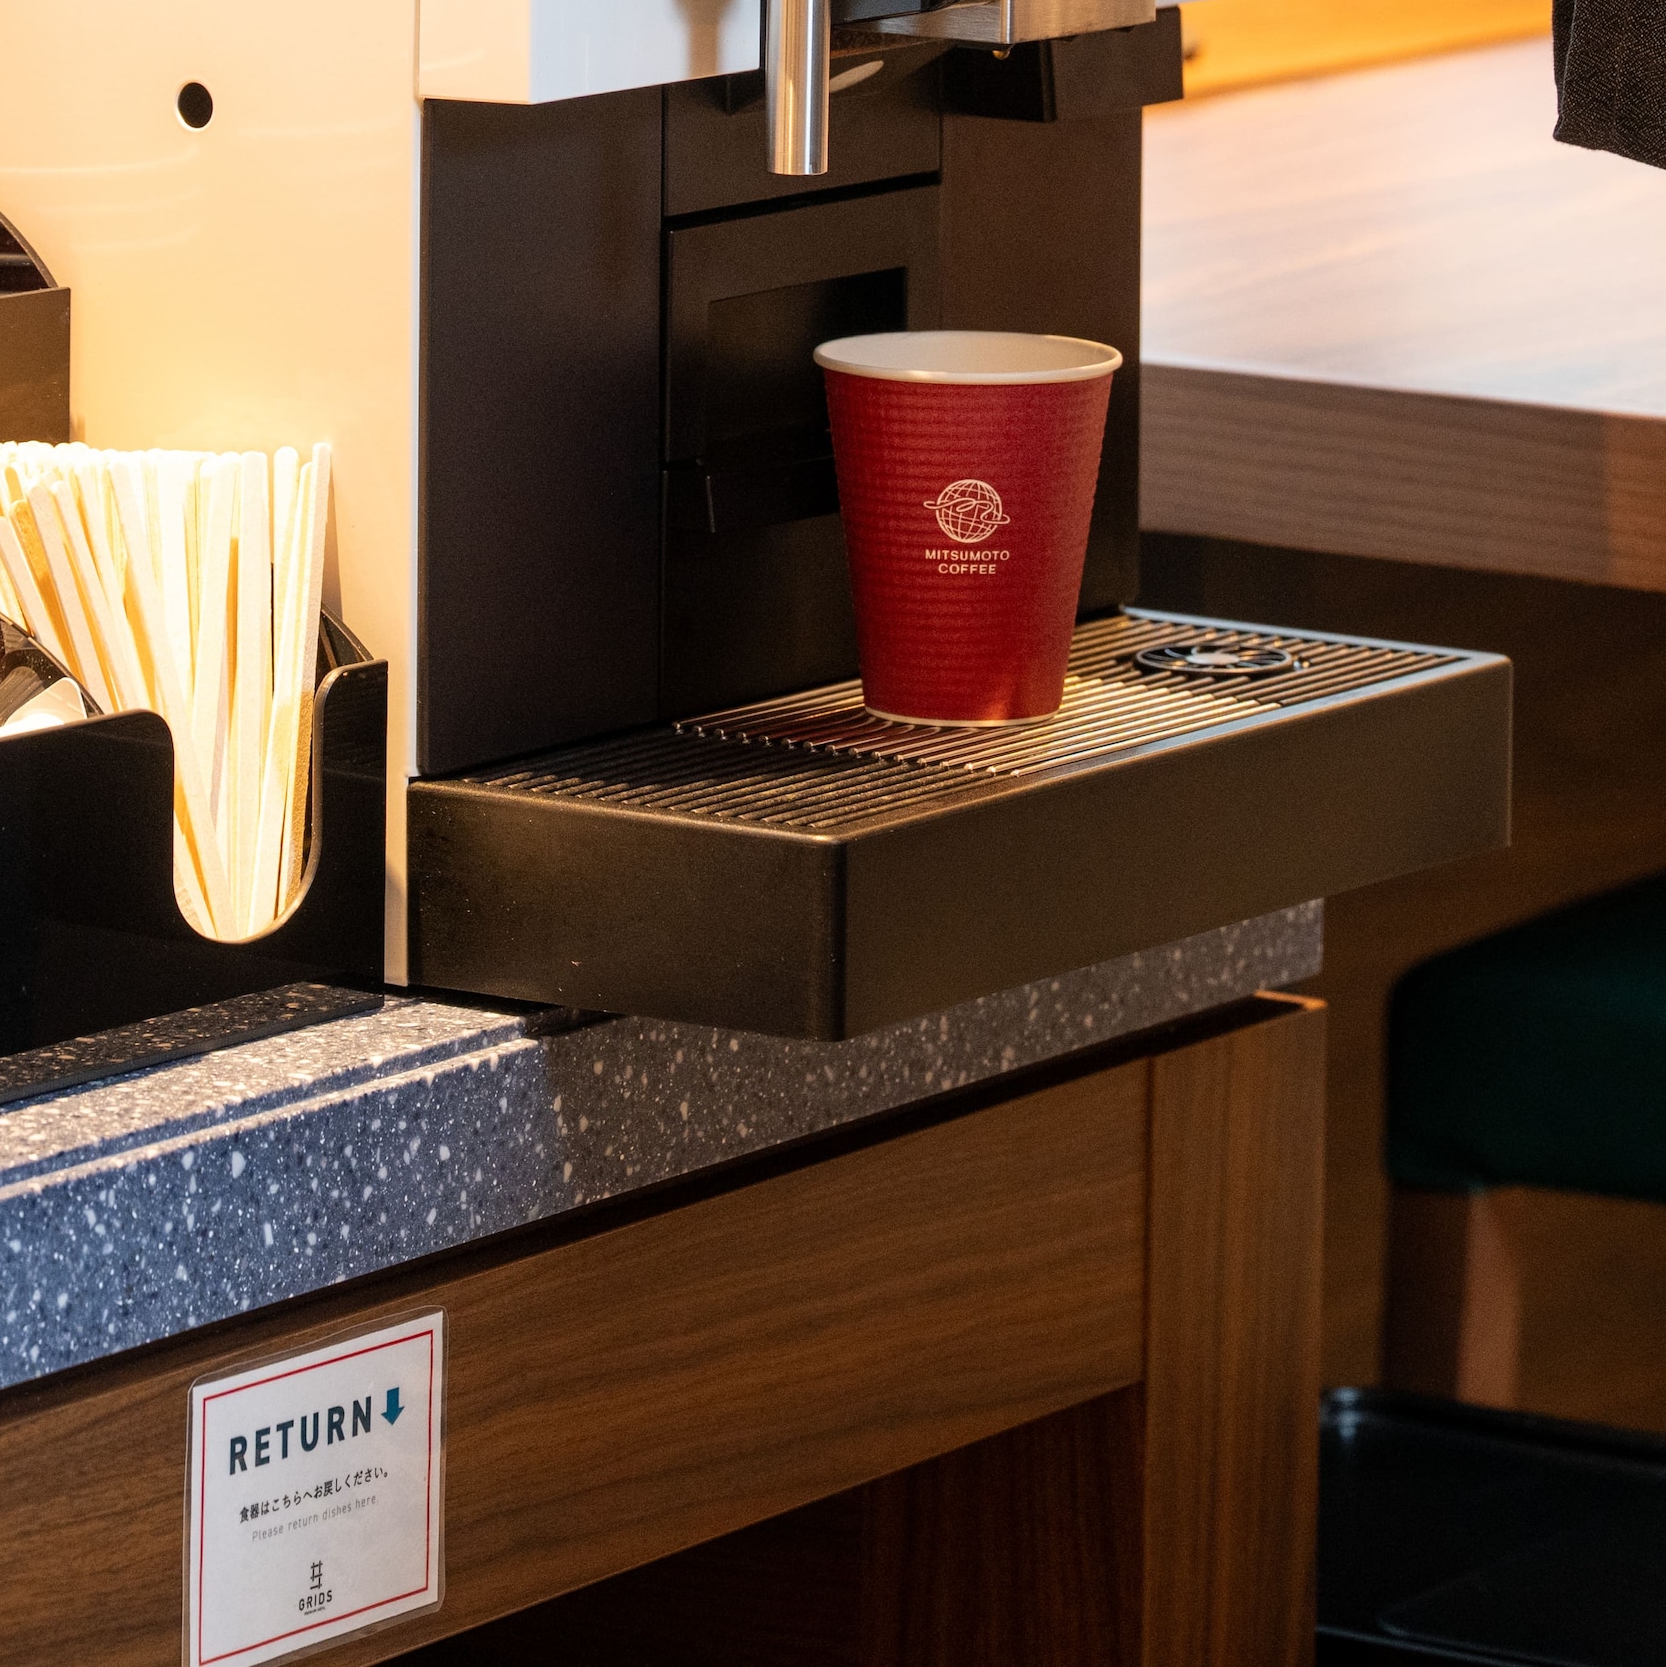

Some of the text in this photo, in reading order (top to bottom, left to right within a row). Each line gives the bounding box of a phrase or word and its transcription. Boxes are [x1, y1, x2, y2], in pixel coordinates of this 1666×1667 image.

[925, 549, 1010, 562] MITSUMOTO
[938, 564, 996, 575] COFFEE
[229, 1395, 372, 1476] RETURN
[239, 1465, 389, 1524] 食器はこちらへお戻しください。
[252, 1522, 284, 1543] Please
[288, 1511, 319, 1532] return
[322, 1501, 352, 1521] dishes
[298, 1589, 333, 1612] GRIDS
